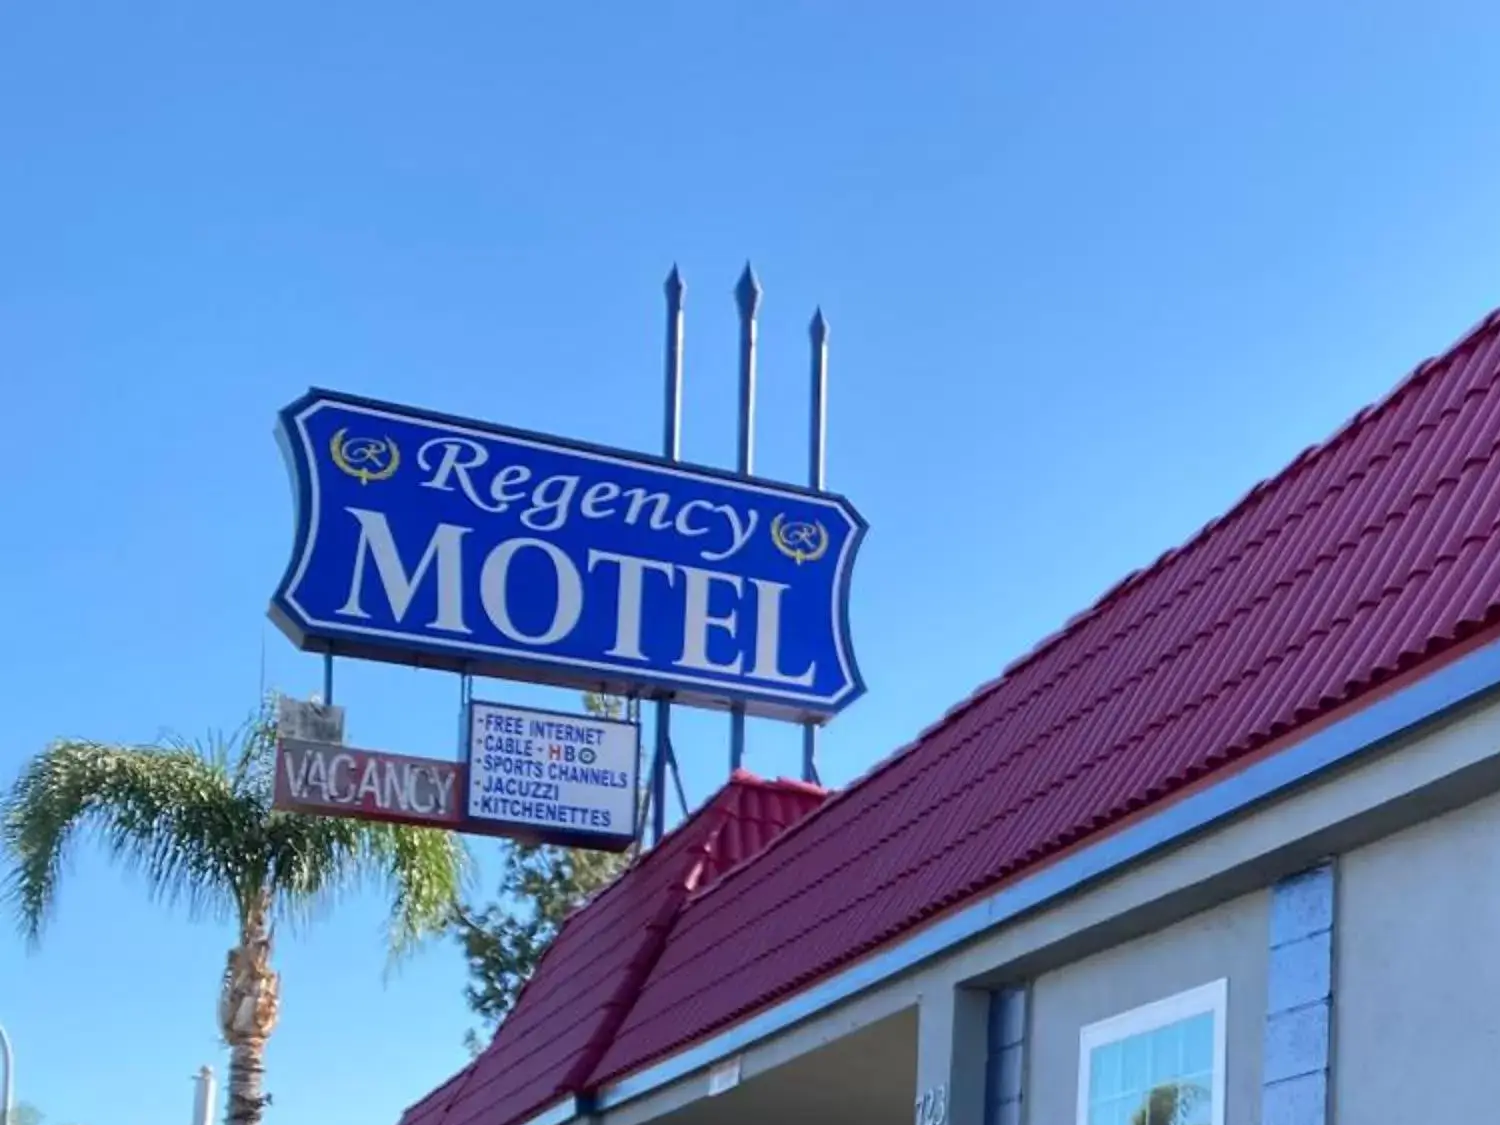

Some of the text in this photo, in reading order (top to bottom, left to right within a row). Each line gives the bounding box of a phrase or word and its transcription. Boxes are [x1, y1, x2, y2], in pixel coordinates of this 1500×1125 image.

[416, 437, 758, 561] Regency
[335, 506, 816, 687] MOTEL
[485, 714, 606, 745] FREE INTERNET
[483, 735, 597, 764] CABLE HBO
[284, 750, 455, 814] VACANCY
[482, 775, 559, 801] JACUZZI
[483, 754, 628, 789] SPORTS CHANNELS
[480, 795, 611, 827] KITCHENETTES
